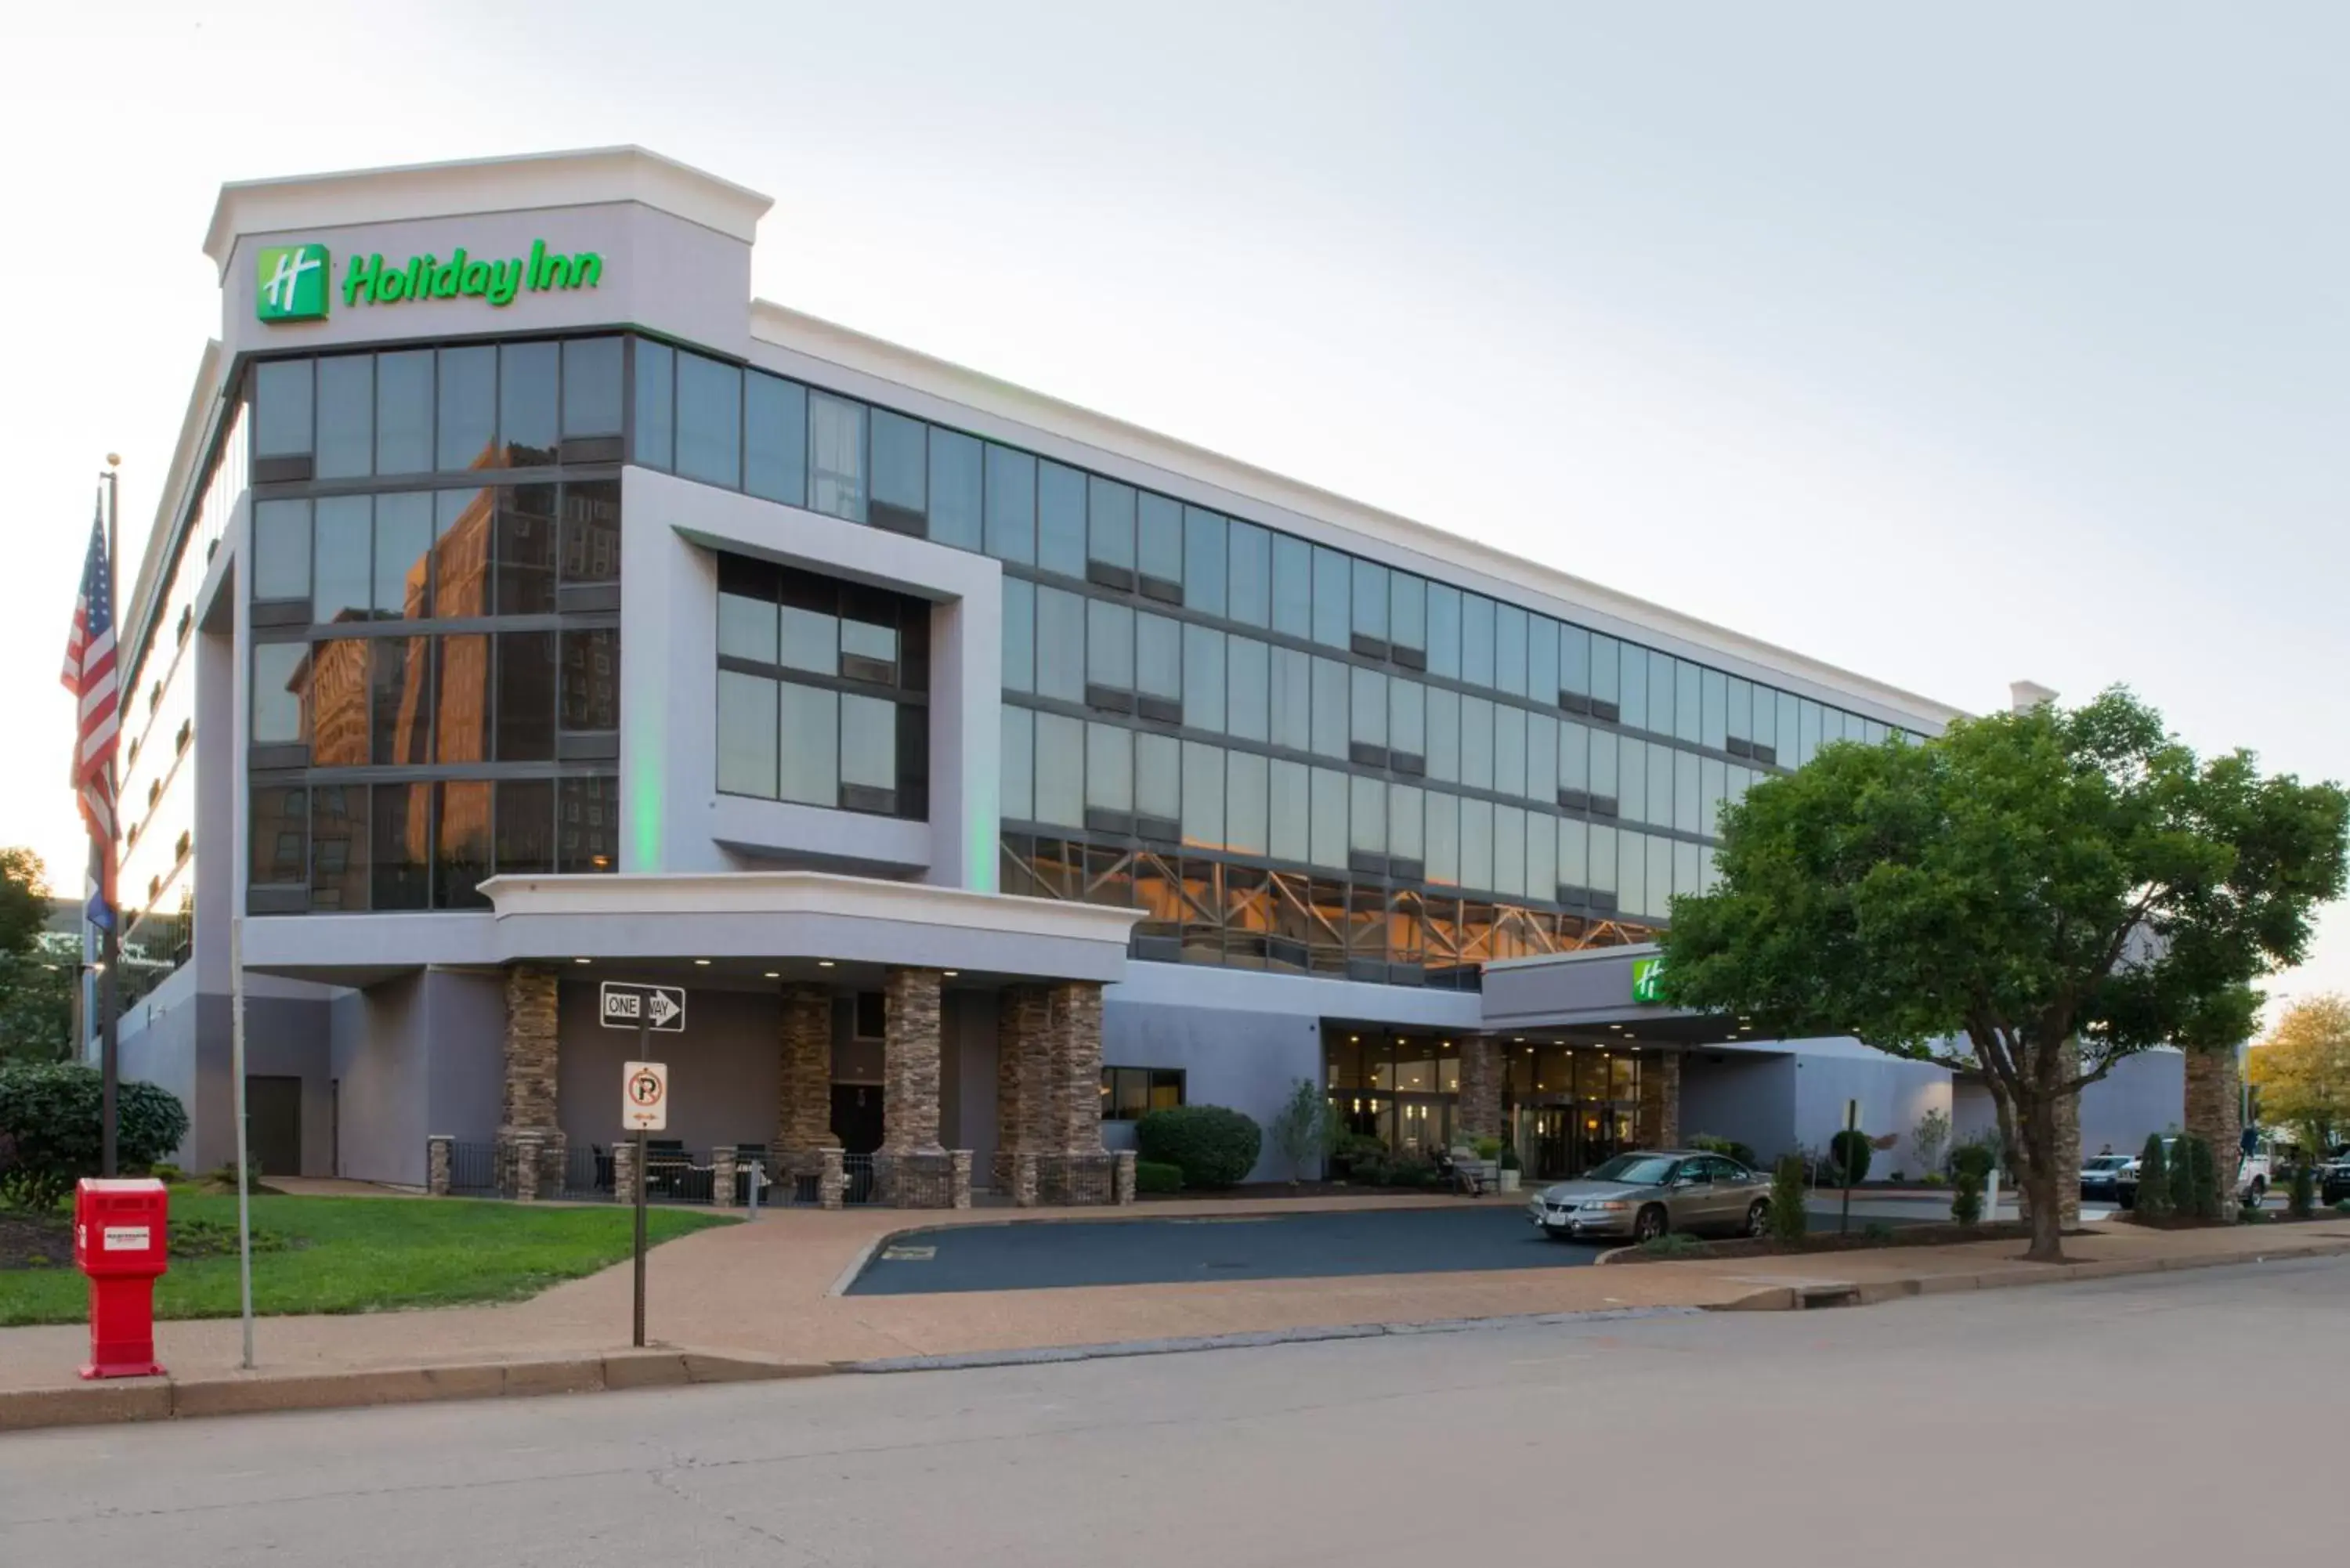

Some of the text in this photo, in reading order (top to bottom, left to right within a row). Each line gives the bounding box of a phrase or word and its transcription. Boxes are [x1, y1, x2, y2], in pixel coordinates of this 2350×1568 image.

[342, 238, 603, 305] Holiday Inn
[609, 997, 637, 1013] ONE
[638, 1078, 656, 1100] P
